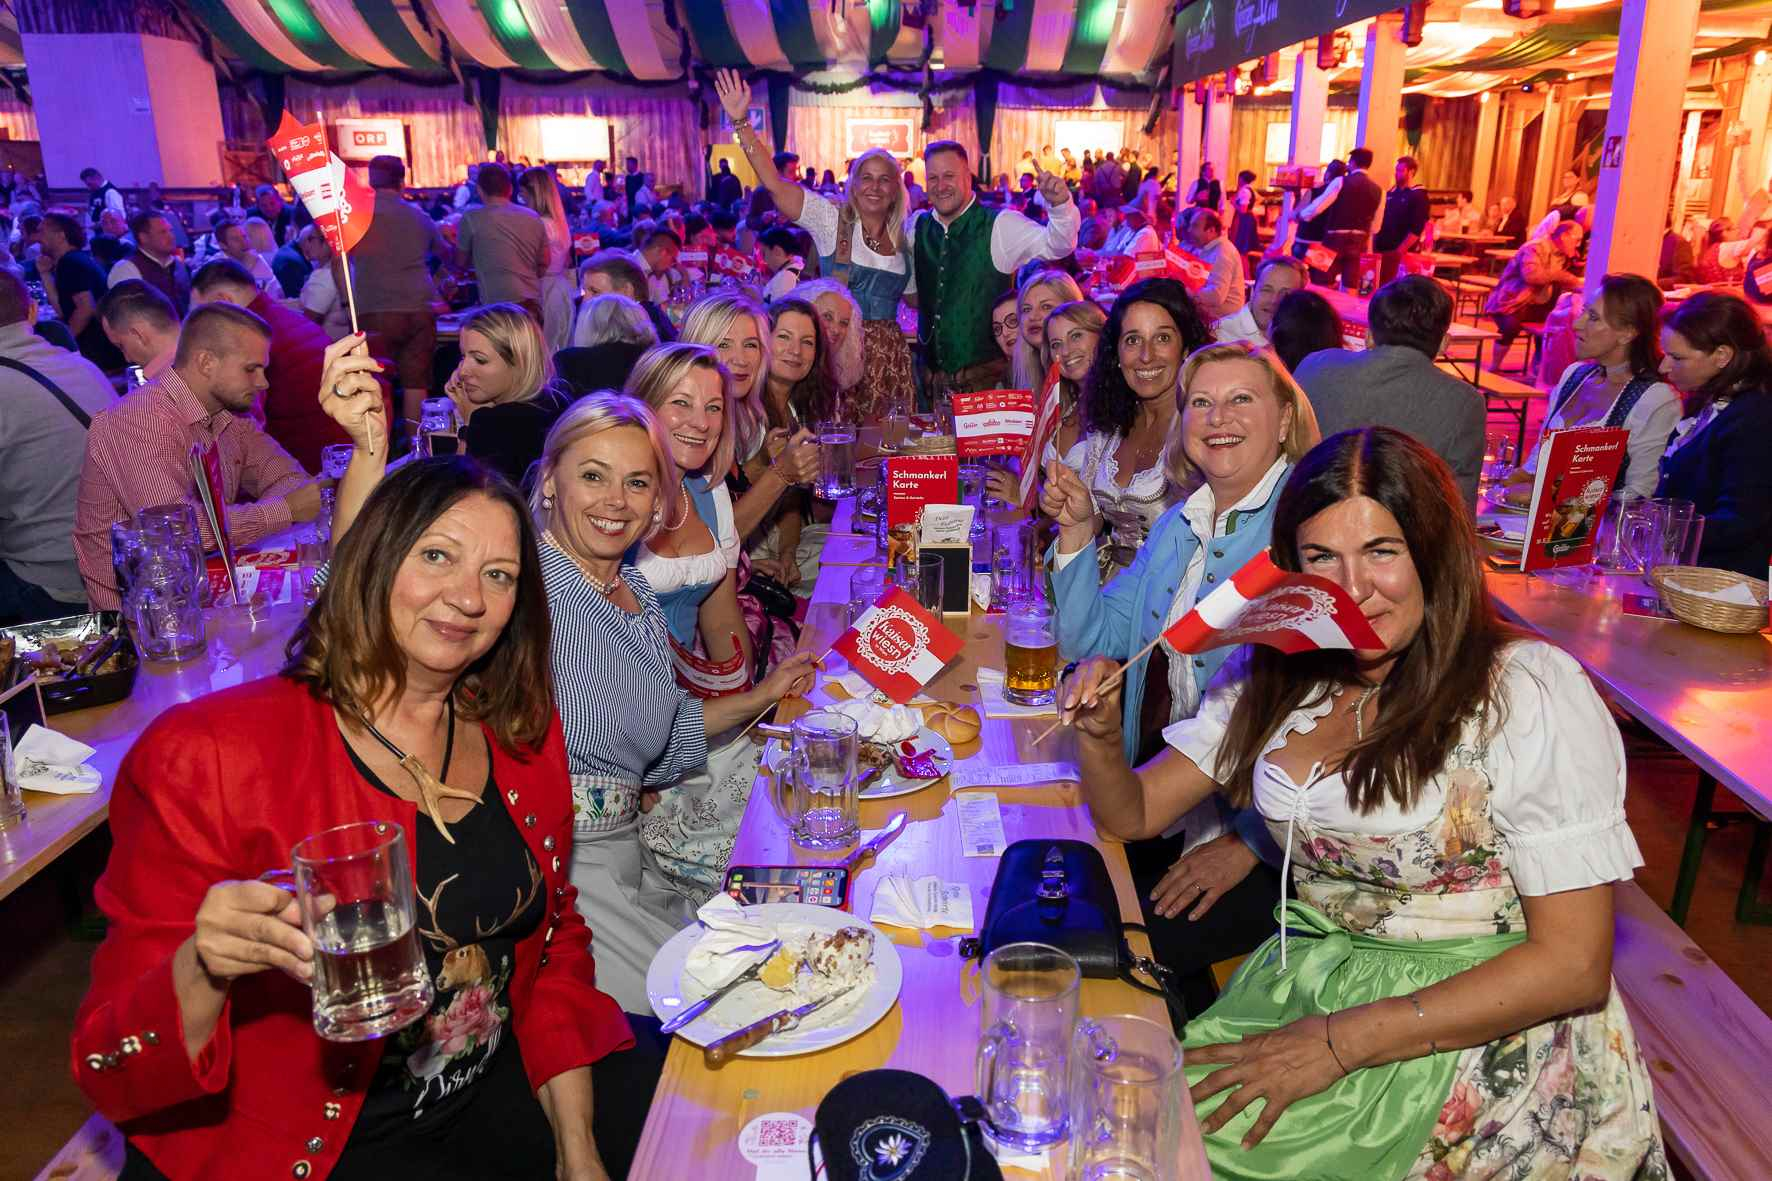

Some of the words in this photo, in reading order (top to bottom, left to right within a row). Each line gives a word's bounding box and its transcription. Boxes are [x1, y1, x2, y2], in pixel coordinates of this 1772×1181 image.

[355, 133, 385, 144] ORF
[1574, 441, 1619, 453] Schmankerl
[1572, 454, 1594, 463] Karte
[892, 470, 947, 480] Schmankerl
[892, 480, 919, 489] Karte
